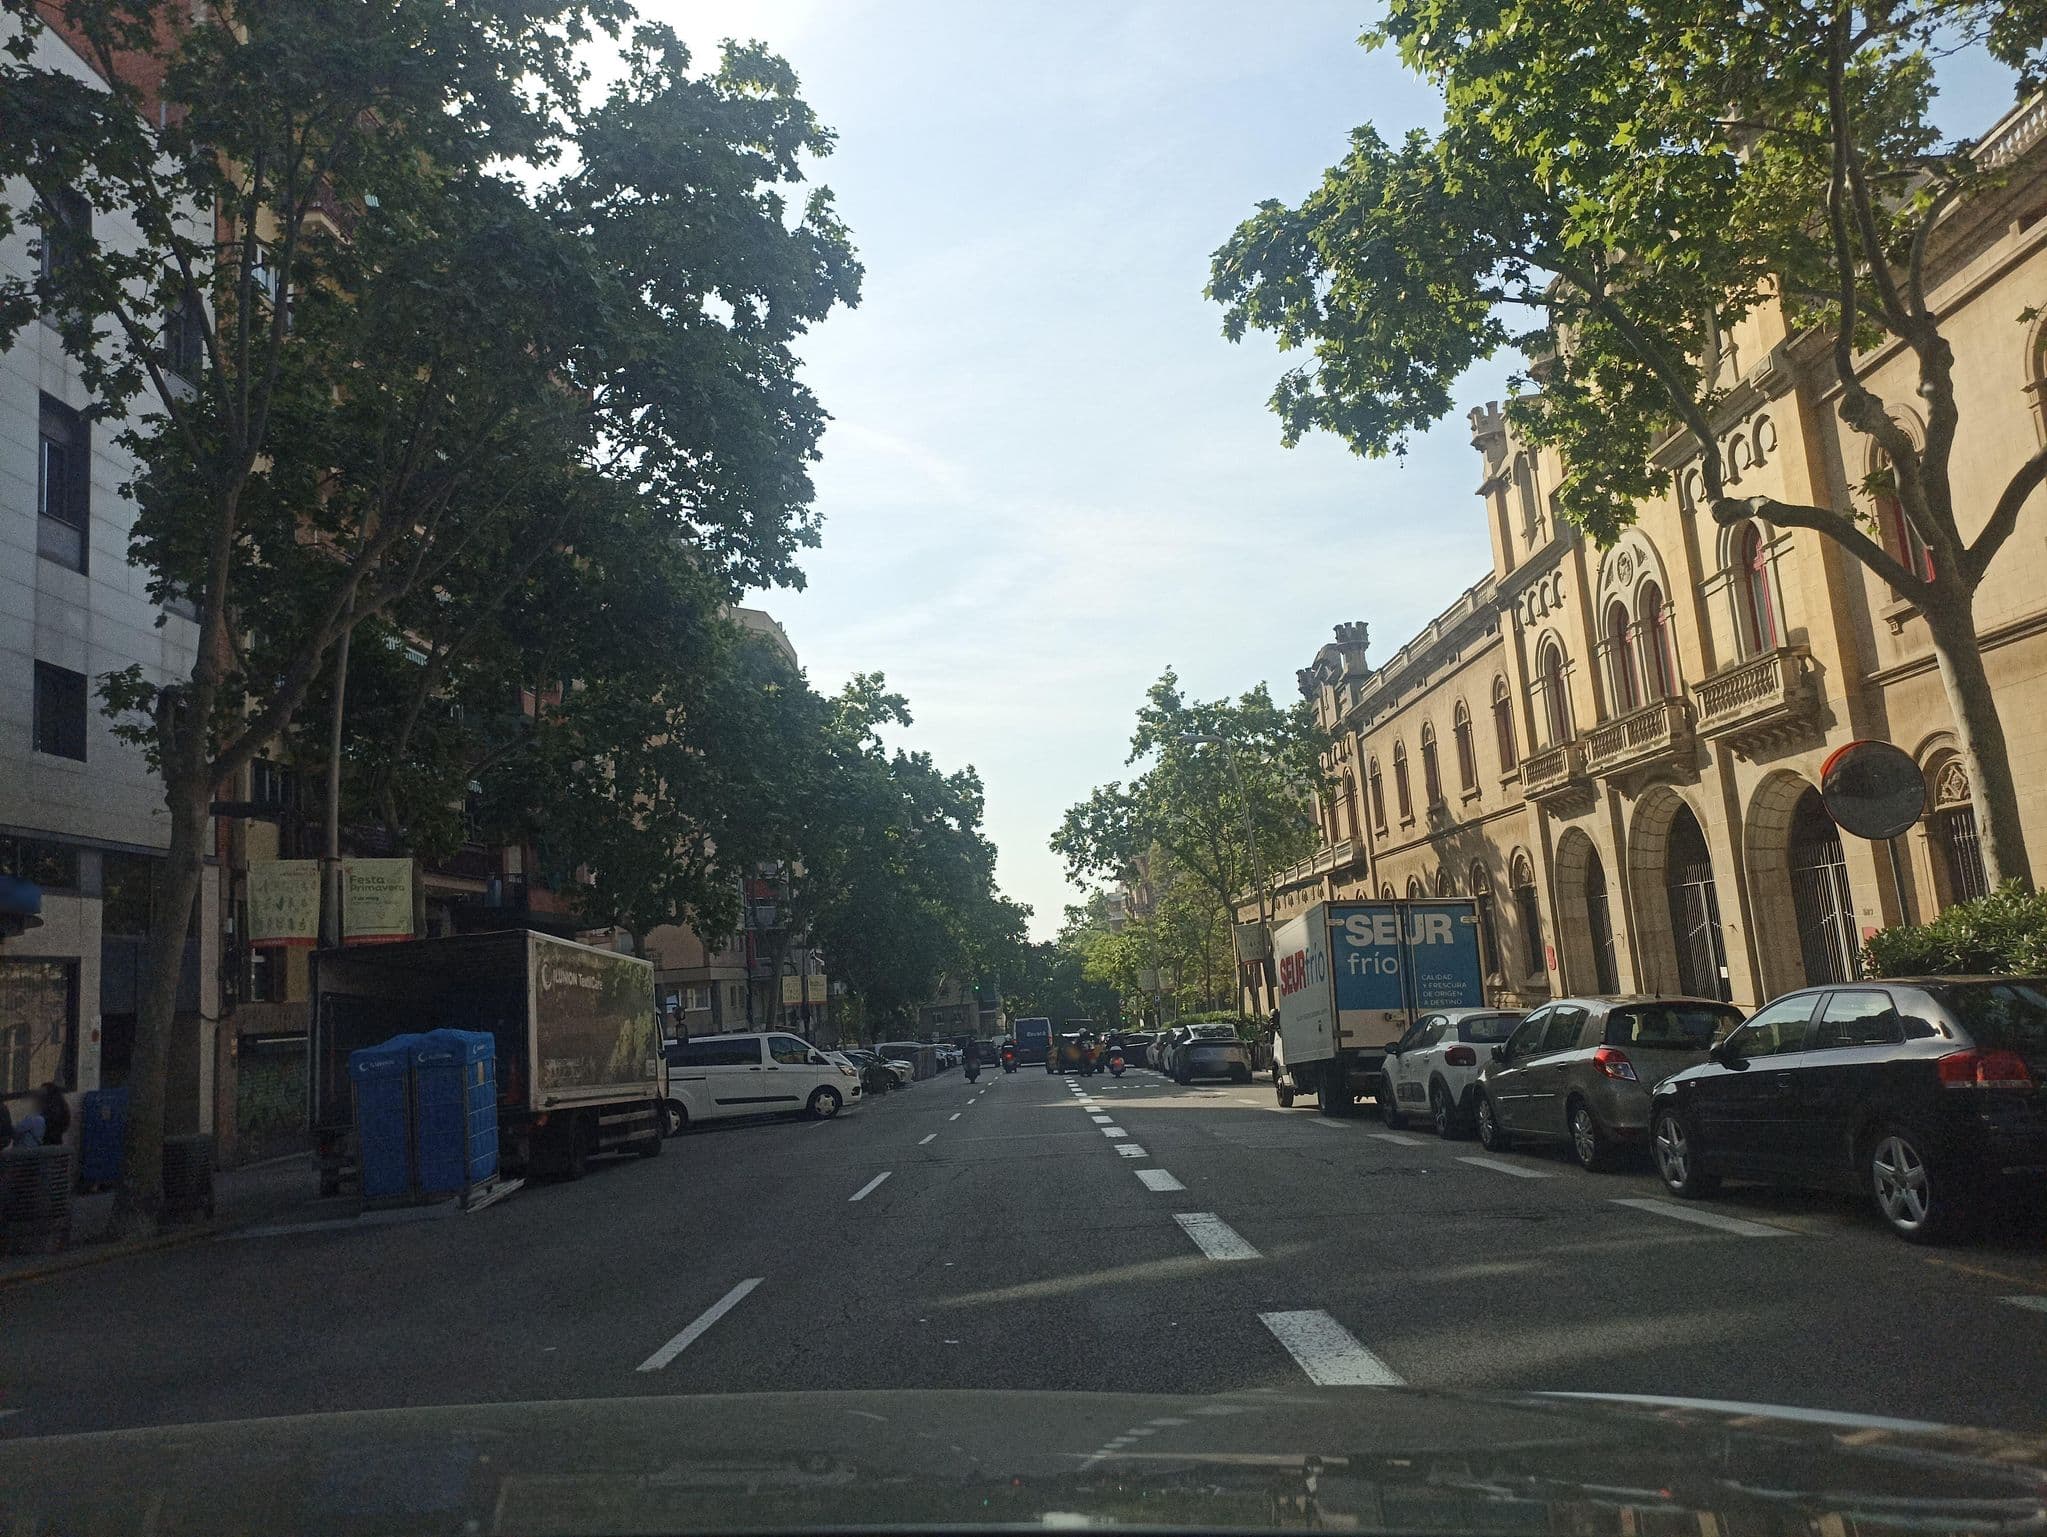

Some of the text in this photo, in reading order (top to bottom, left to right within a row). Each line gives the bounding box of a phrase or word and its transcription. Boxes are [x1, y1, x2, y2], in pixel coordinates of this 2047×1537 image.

[350, 875, 385, 884] Festa
[350, 884, 405, 892] Primavera
[1345, 913, 1453, 946] SEUR
[1347, 952, 1399, 975] frío
